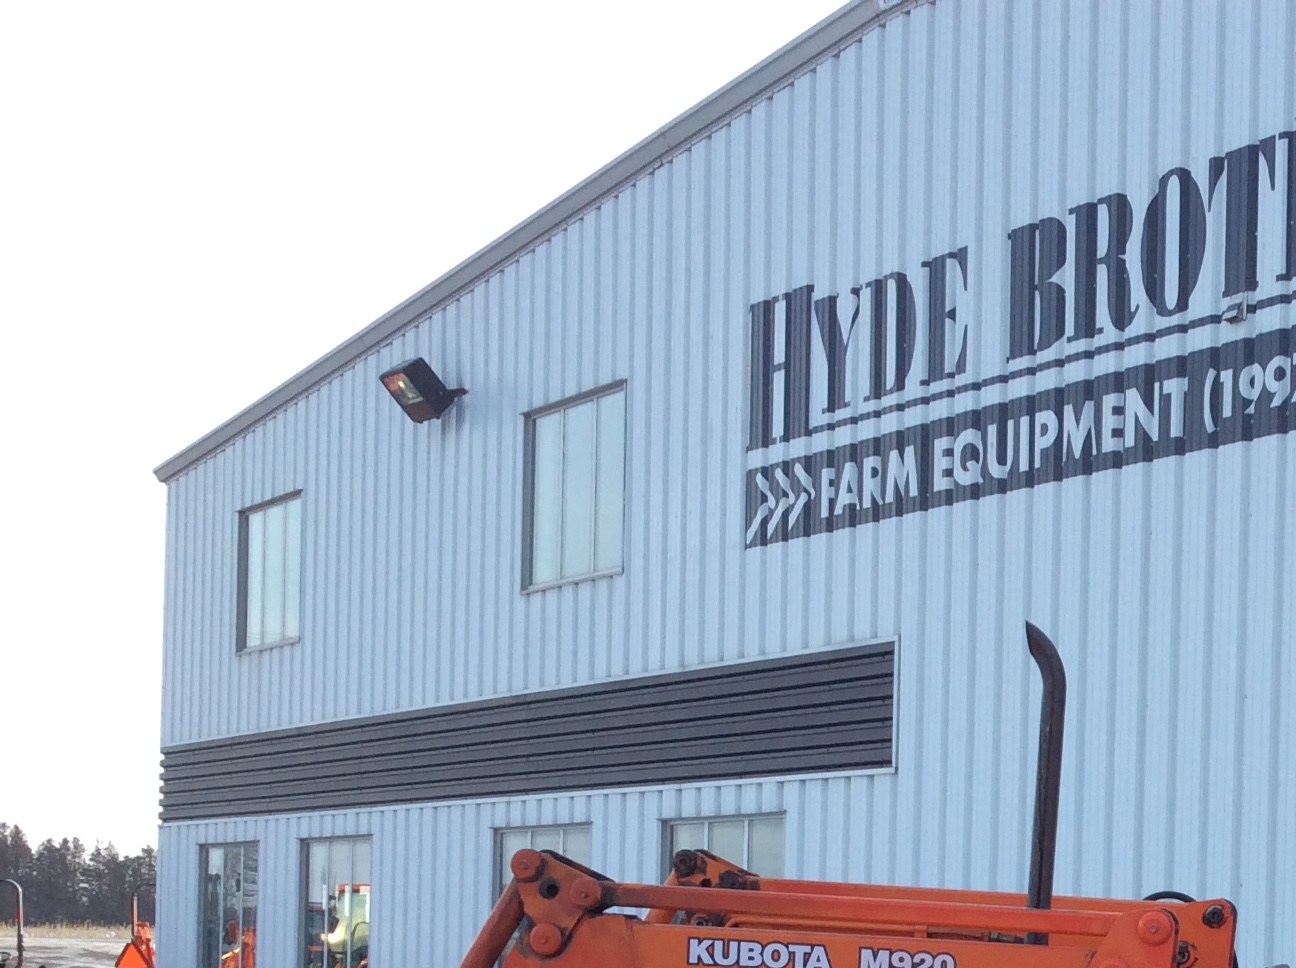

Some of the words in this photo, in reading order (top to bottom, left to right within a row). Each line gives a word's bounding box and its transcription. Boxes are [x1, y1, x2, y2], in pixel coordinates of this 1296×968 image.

[748, 246, 968, 453] HYDE
[820, 444, 918, 518] FARM
[934, 376, 1188, 491] EQUIPMENT
